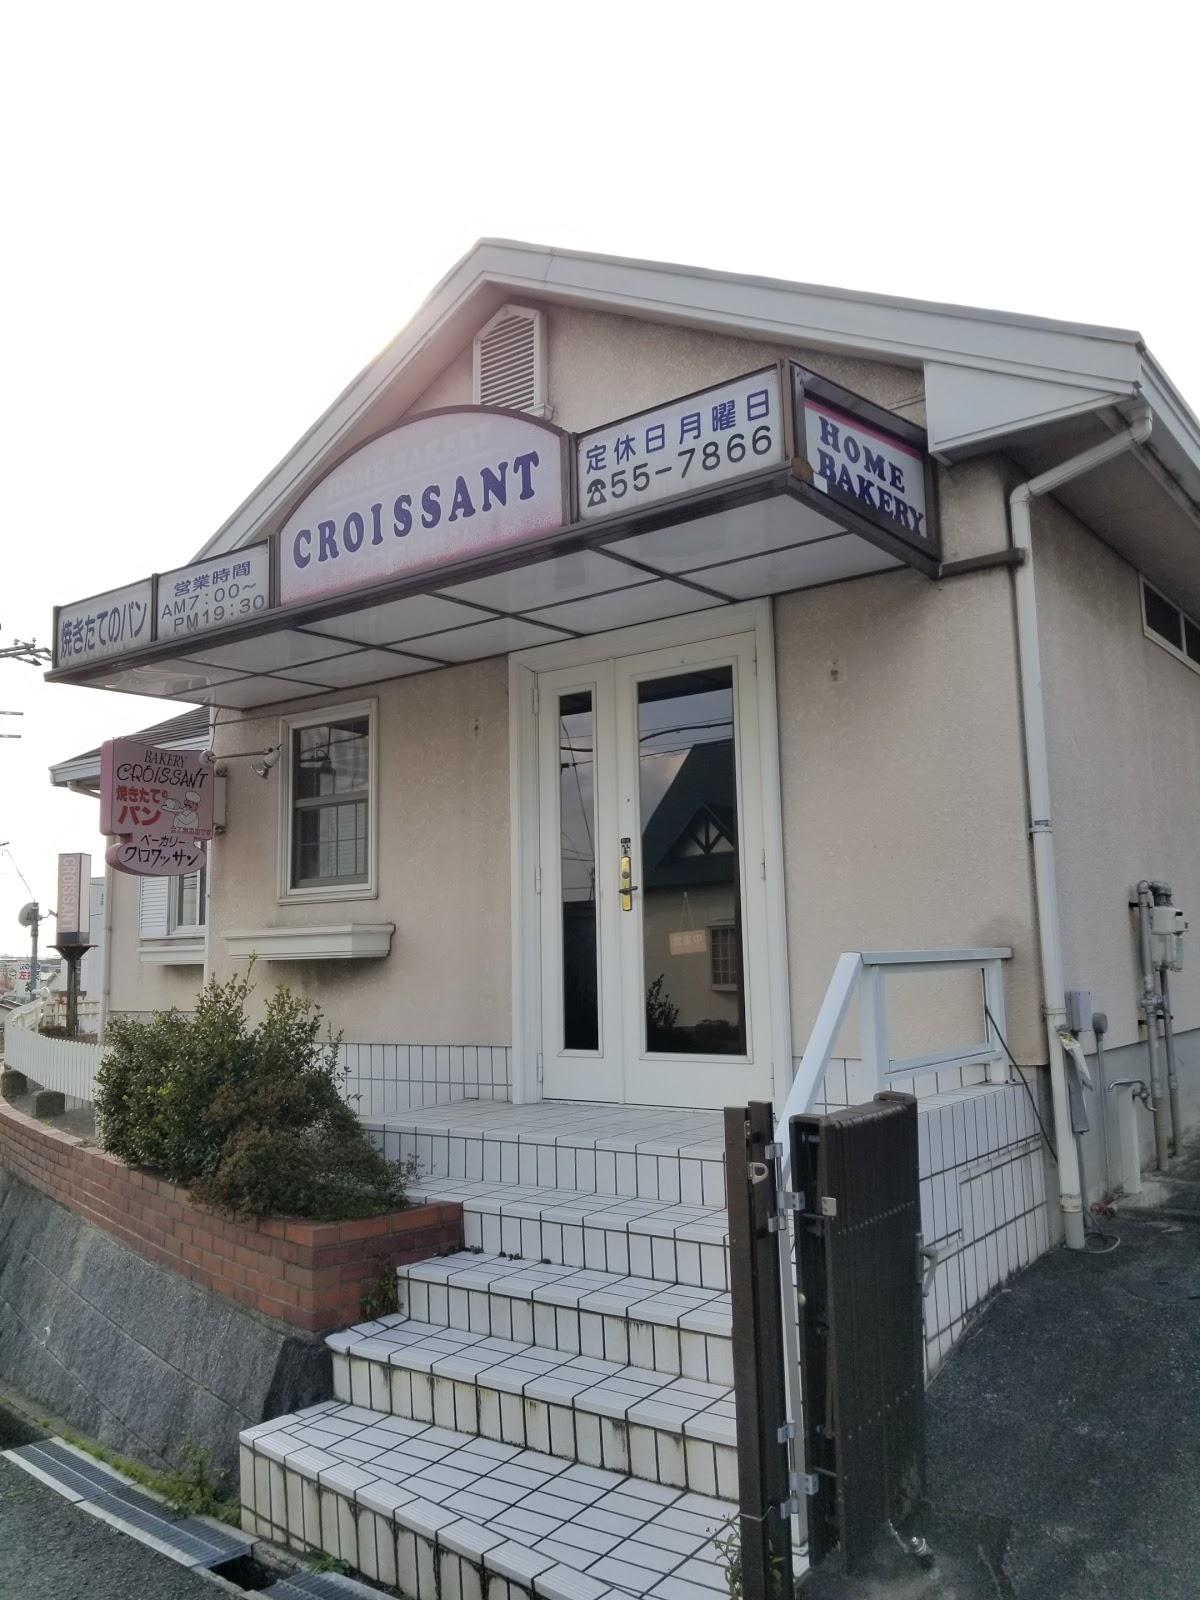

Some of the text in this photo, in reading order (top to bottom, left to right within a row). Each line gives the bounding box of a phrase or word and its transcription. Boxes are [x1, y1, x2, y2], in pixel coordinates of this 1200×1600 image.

[586, 389, 769, 474] 定休日月曜日
[610, 425, 772, 499] 55-7866
[819, 416, 905, 494] HOME
[293, 451, 539, 568] CROISSANT
[817, 447, 924, 536] BAKERY
[174, 561, 251, 597] 営業時間
[61, 602, 148, 658] 焼きたてのパン
[174, 595, 265, 633] PM19:30
[117, 763, 208, 789] CROISSANT
[144, 750, 184, 768] BAKERY
[117, 805, 162, 826] パン
[122, 846, 199, 868] クロワッサン
[140, 834, 186, 848] ベーカリー
